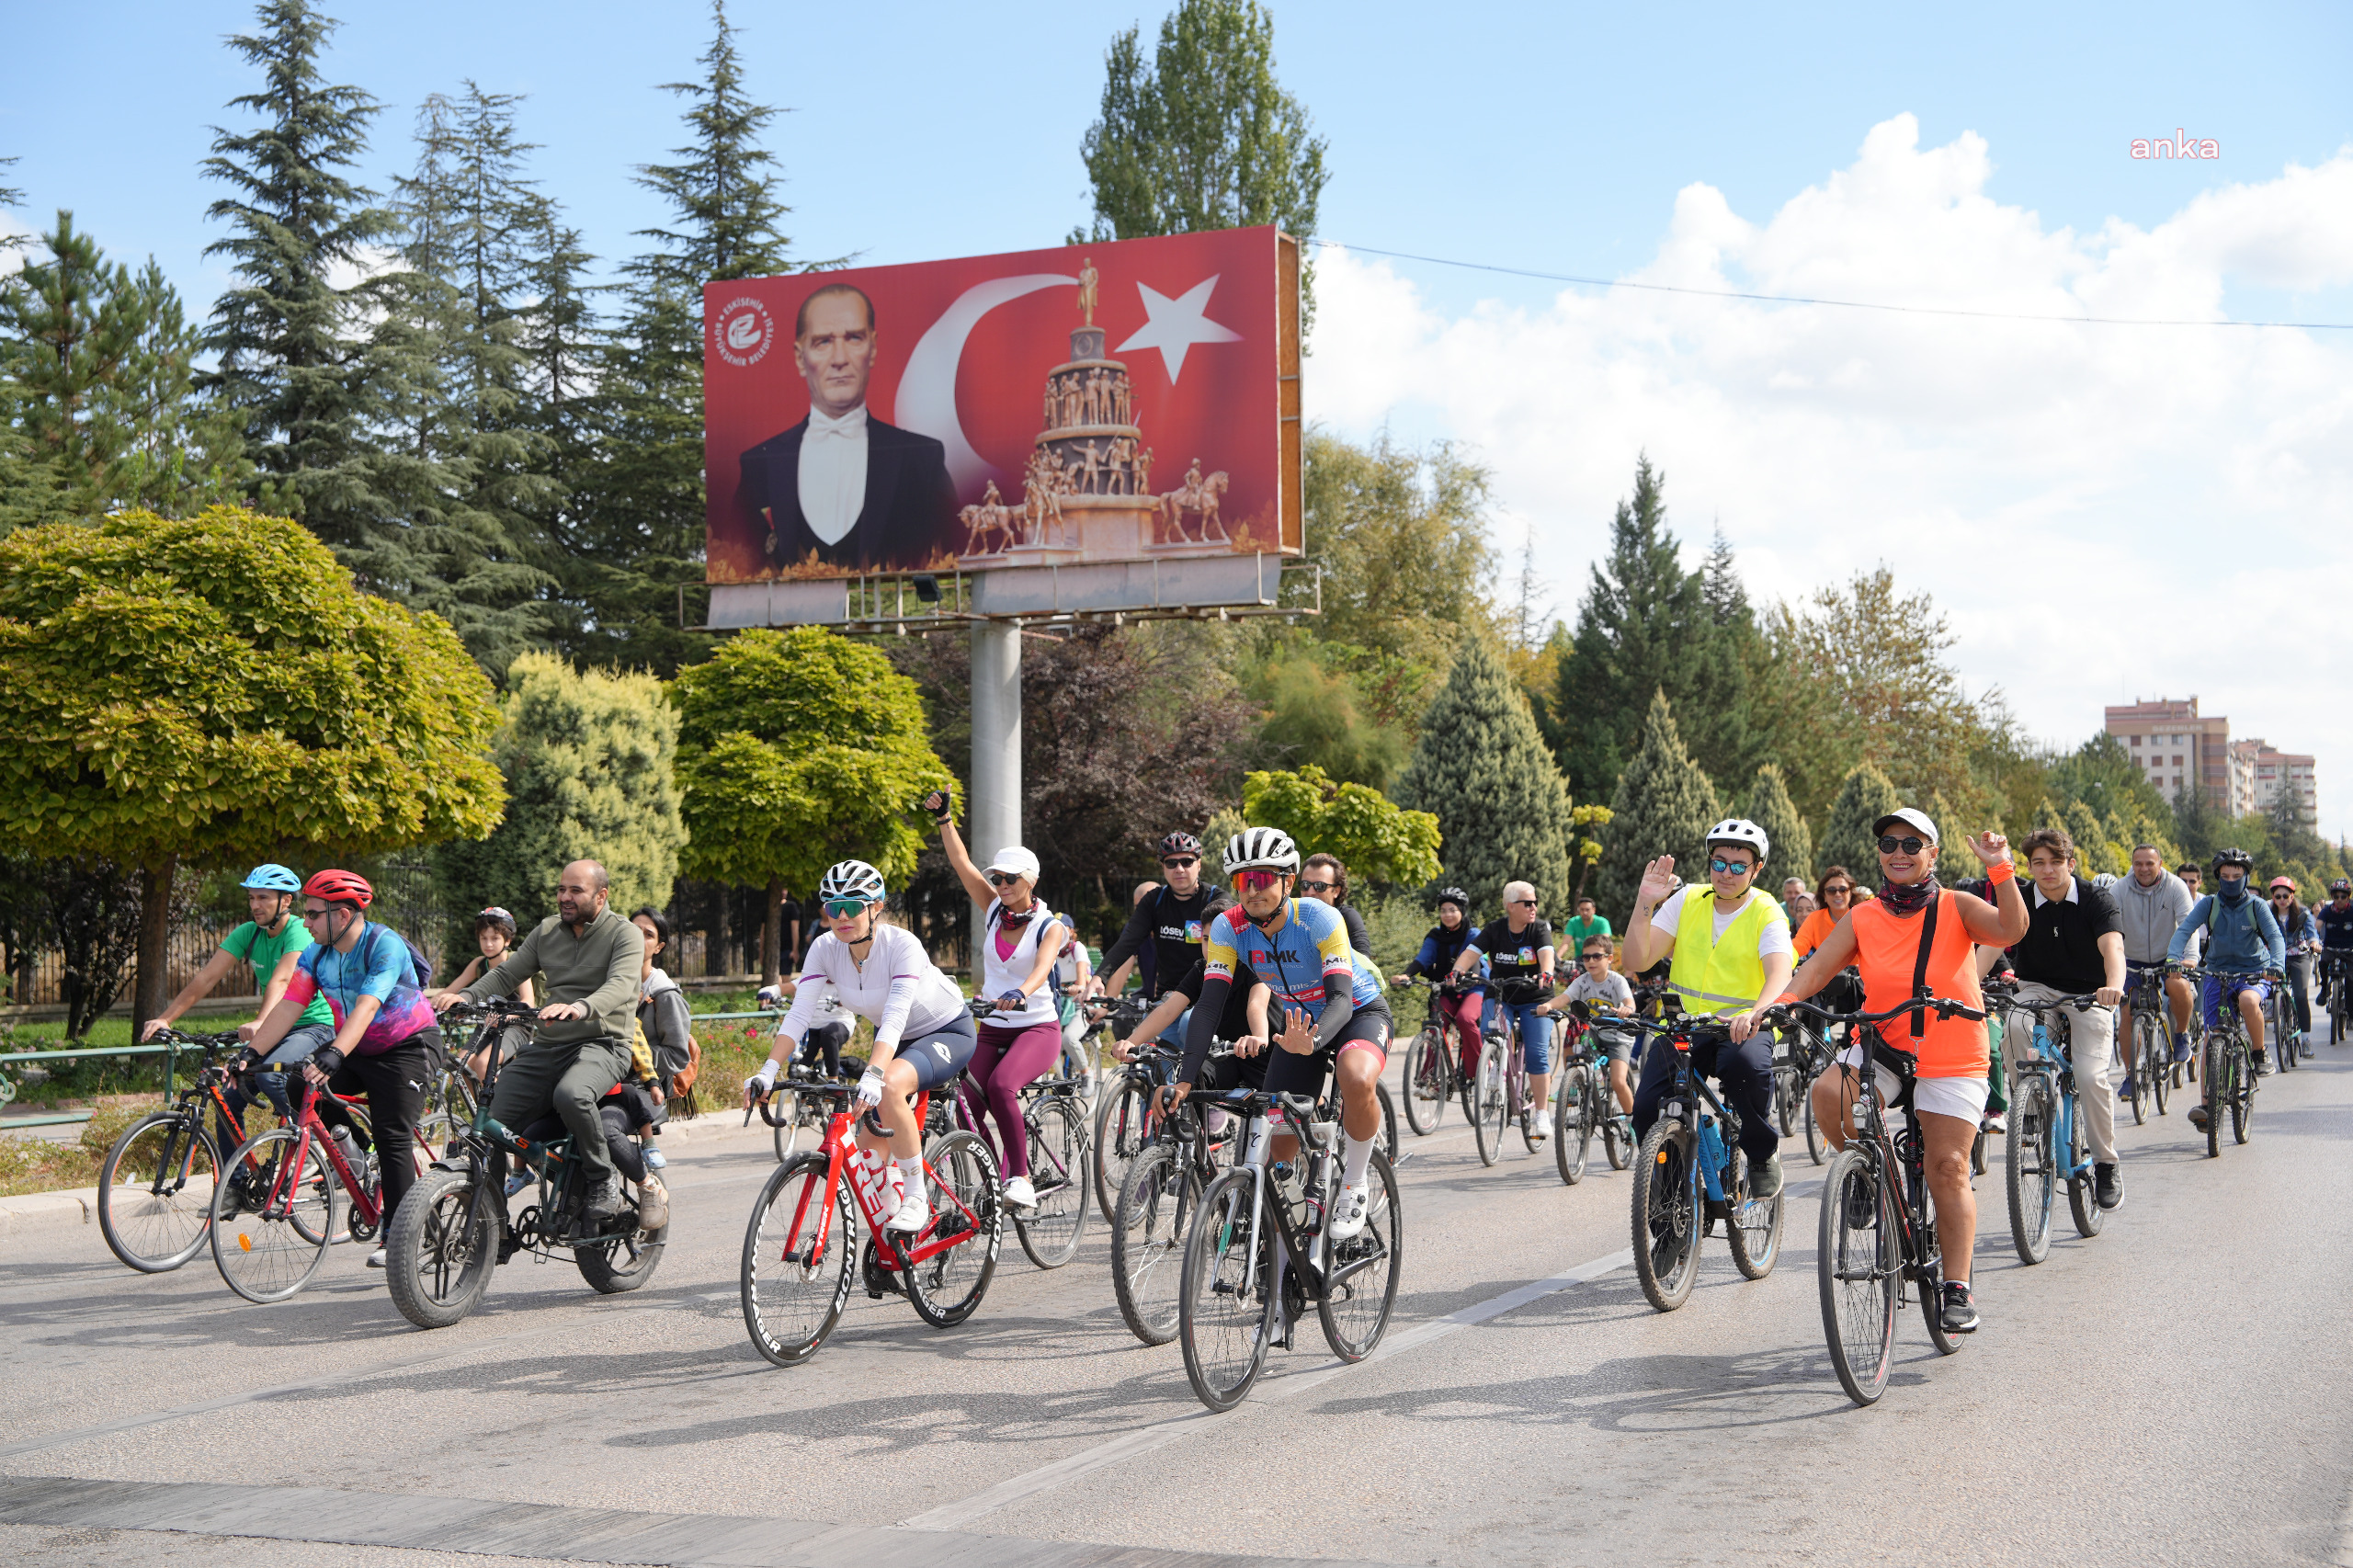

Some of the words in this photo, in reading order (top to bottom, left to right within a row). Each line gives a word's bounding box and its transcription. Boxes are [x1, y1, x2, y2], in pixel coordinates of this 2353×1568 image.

[1160, 926, 1185, 937] LÖSEV
[1495, 951, 1518, 961] LÖSEV
[817, 1204, 829, 1247] TREK
[967, 1141, 1002, 1263] BONTRAGER
[750, 1202, 781, 1354] BONTRAGER
[835, 1177, 856, 1314] BONTRAGE
